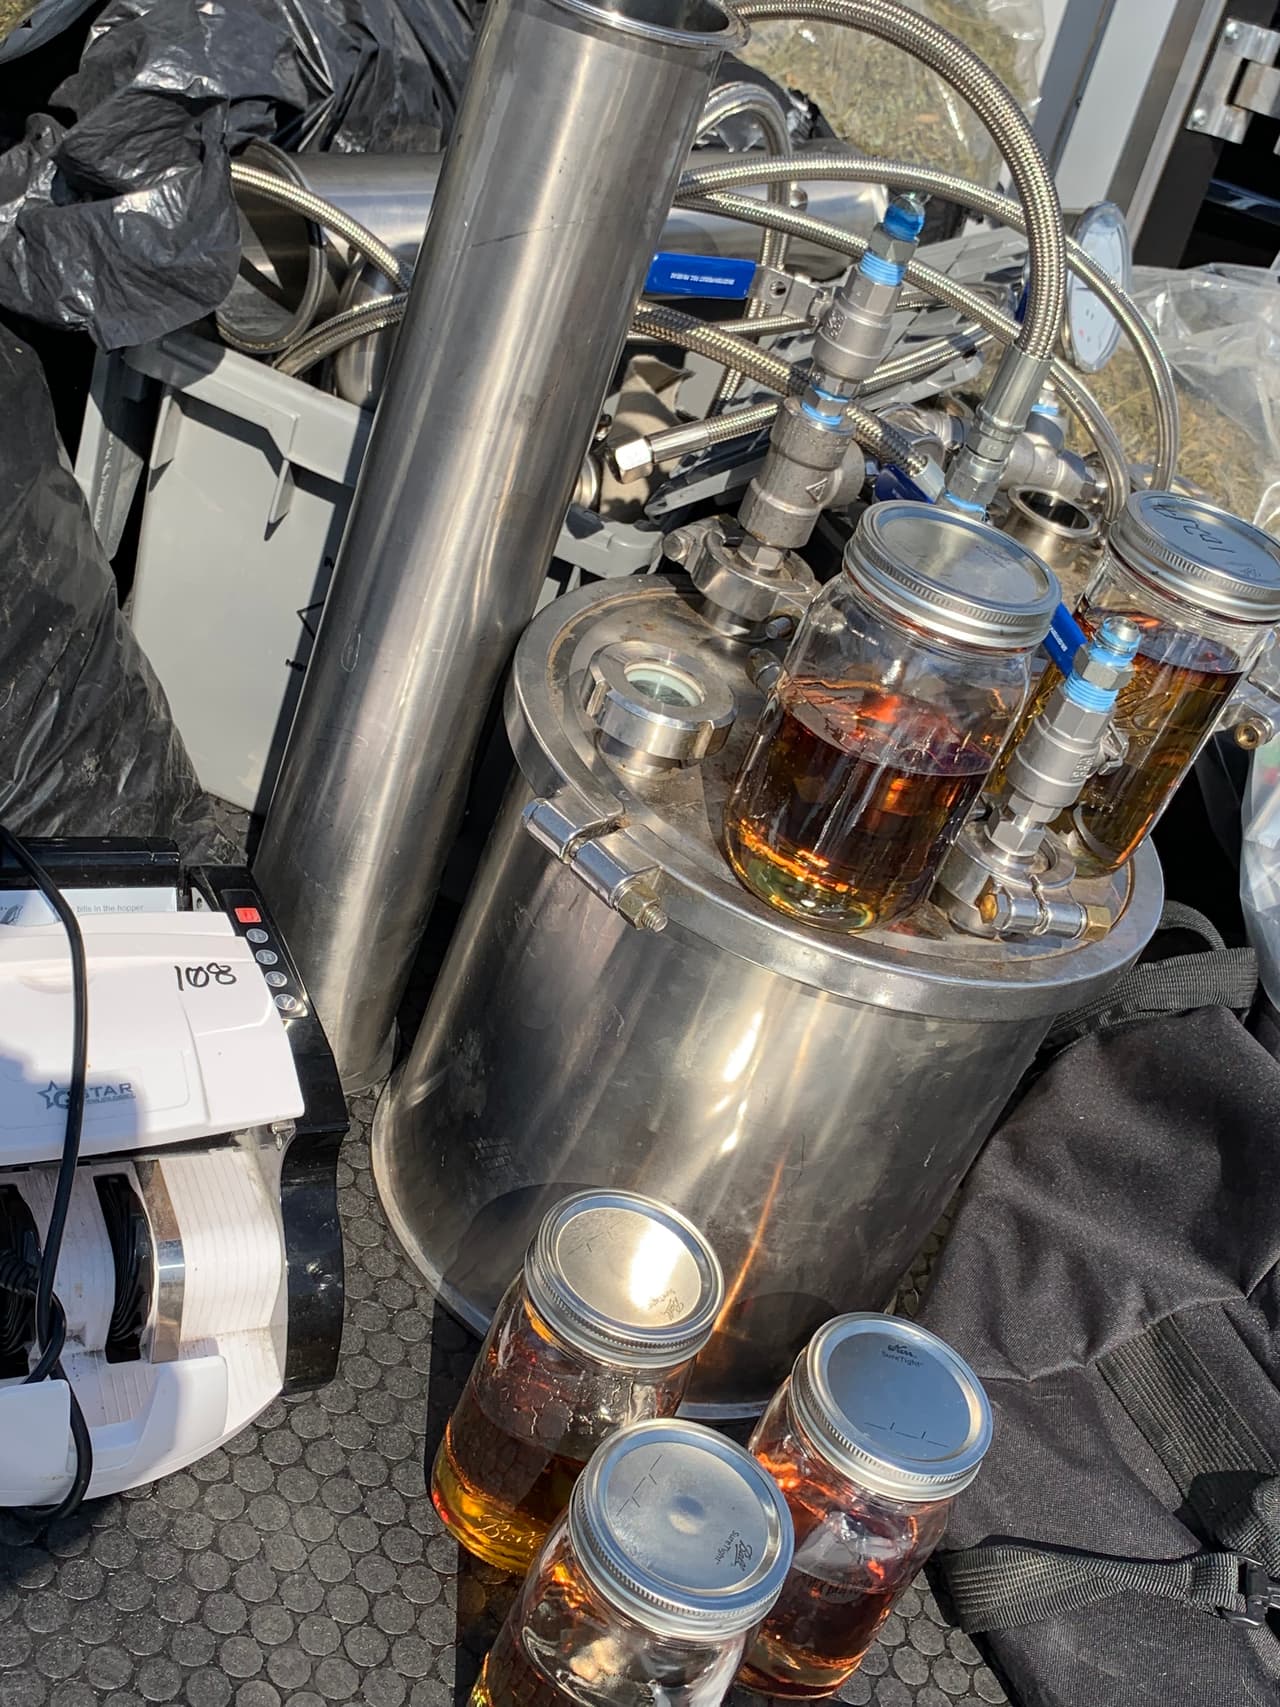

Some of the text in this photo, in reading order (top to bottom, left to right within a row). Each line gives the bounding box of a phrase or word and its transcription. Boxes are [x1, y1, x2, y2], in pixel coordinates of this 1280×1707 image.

[103, 904, 115, 912] the
[117, 903, 144, 913] hopper
[174, 962, 237, 992] 108
